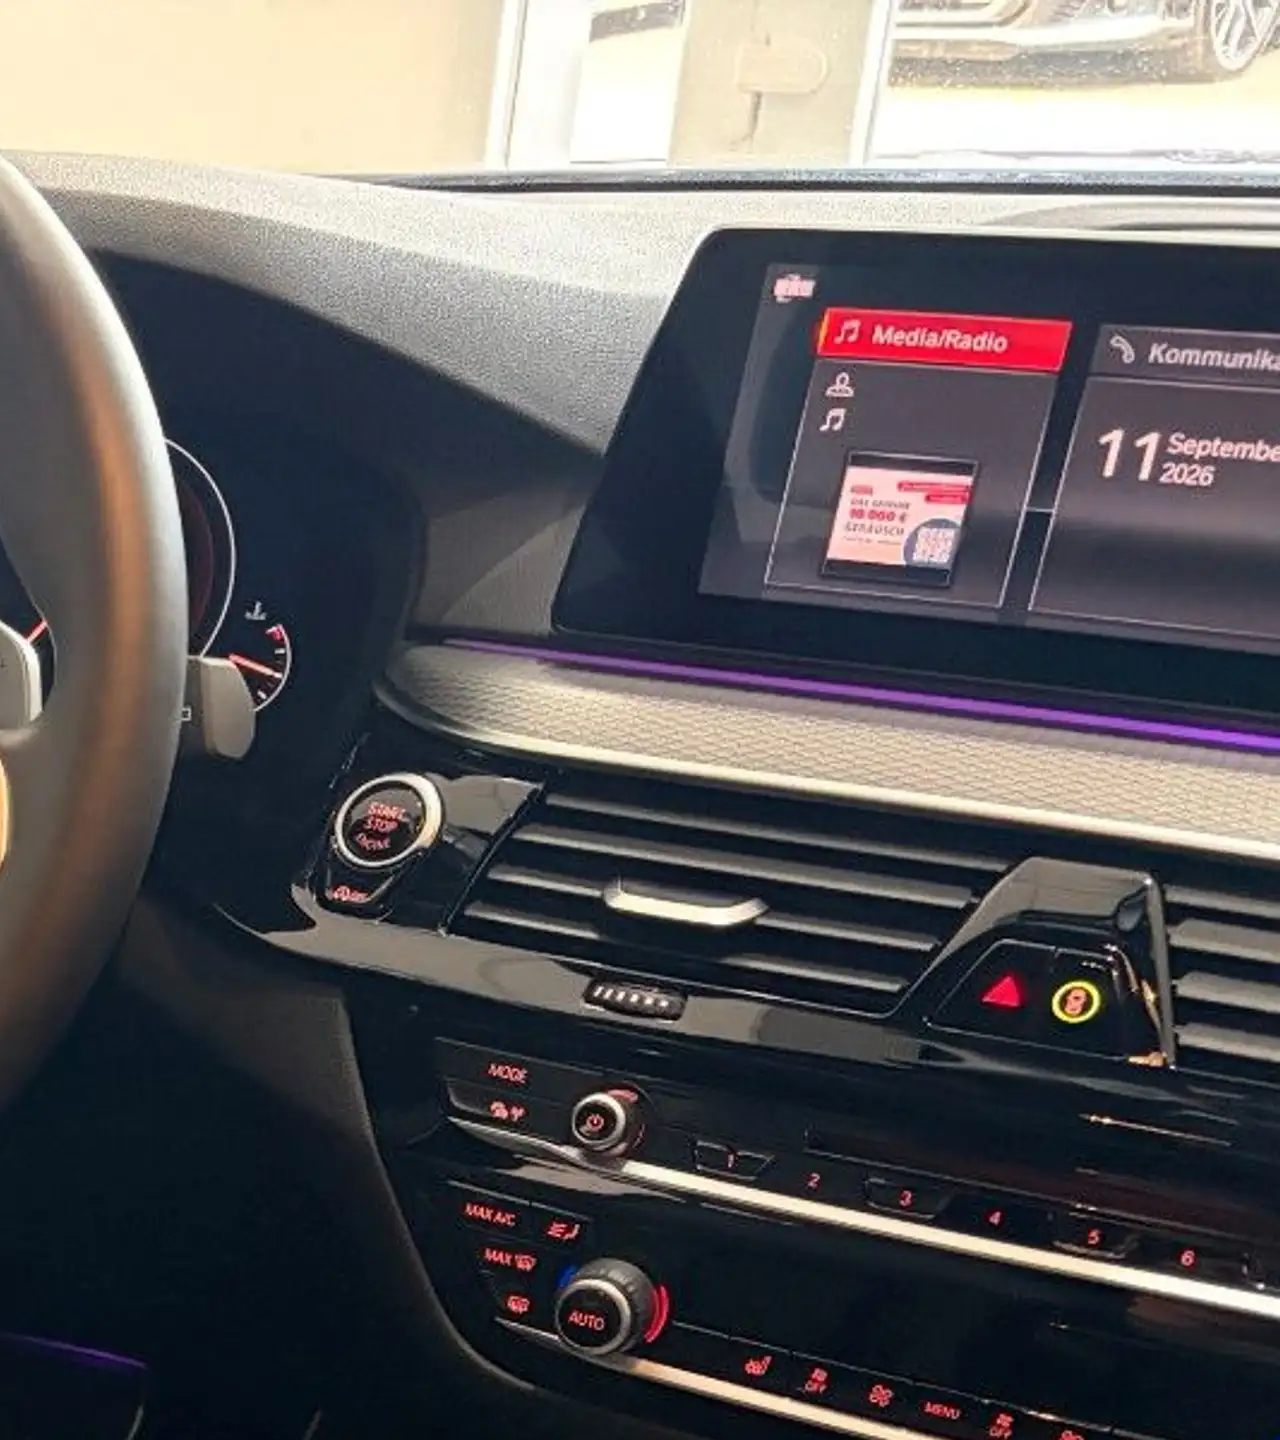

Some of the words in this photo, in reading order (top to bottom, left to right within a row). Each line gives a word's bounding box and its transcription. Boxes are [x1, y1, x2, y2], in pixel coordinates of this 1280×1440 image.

[871, 324, 1008, 353] Media/Radio
[1098, 428, 1161, 482] 11
[1159, 461, 1216, 486] 2026
[488, 1064, 528, 1084] MODE
[807, 1172, 821, 1190] 2
[900, 1190, 913, 1208] 3
[465, 1203, 495, 1221] MAX
[989, 1210, 1003, 1226] 4
[1088, 1228, 1101, 1245] 5
[484, 1248, 512, 1267] MAX
[1180, 1249, 1196, 1268] 6
[567, 1309, 606, 1331] AUTO
[923, 1401, 961, 1420] MENU
